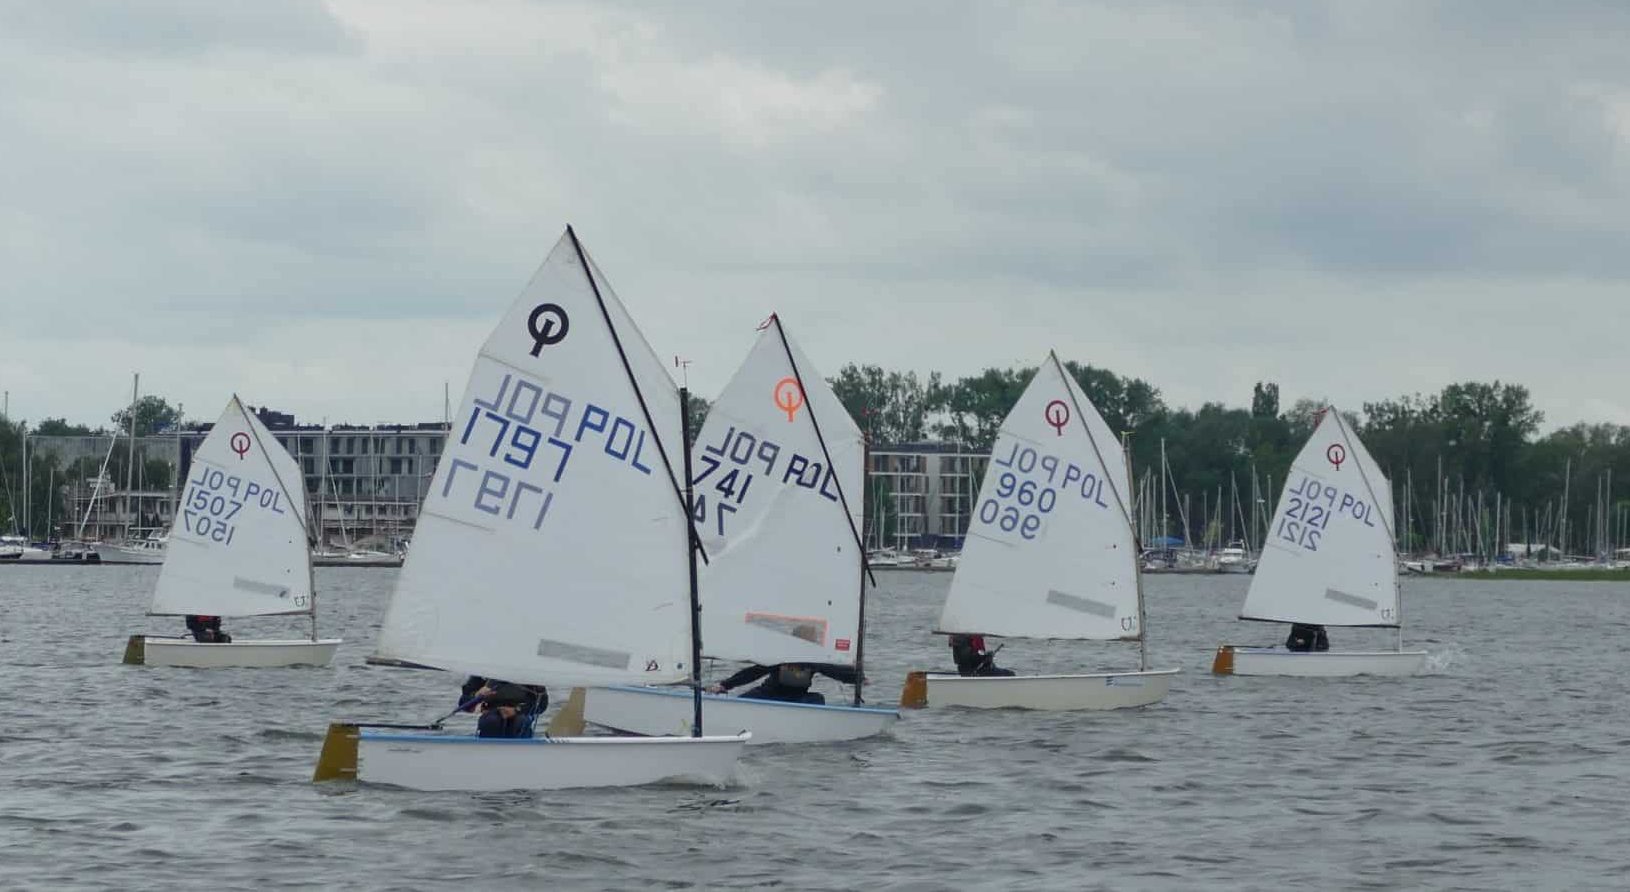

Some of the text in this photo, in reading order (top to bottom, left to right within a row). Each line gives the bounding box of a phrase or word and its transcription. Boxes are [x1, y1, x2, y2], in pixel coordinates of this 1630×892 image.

[461, 407, 573, 483] 1797
[574, 404, 652, 475] POL
[244, 481, 284, 514] POL
[693, 455, 753, 503] 741
[782, 454, 838, 502] POL
[997, 473, 1056, 513] 960
[1062, 463, 1108, 508] POL
[187, 487, 242, 520] 1507
[1286, 498, 1331, 530] 2121
[1339, 493, 1374, 527] POL
